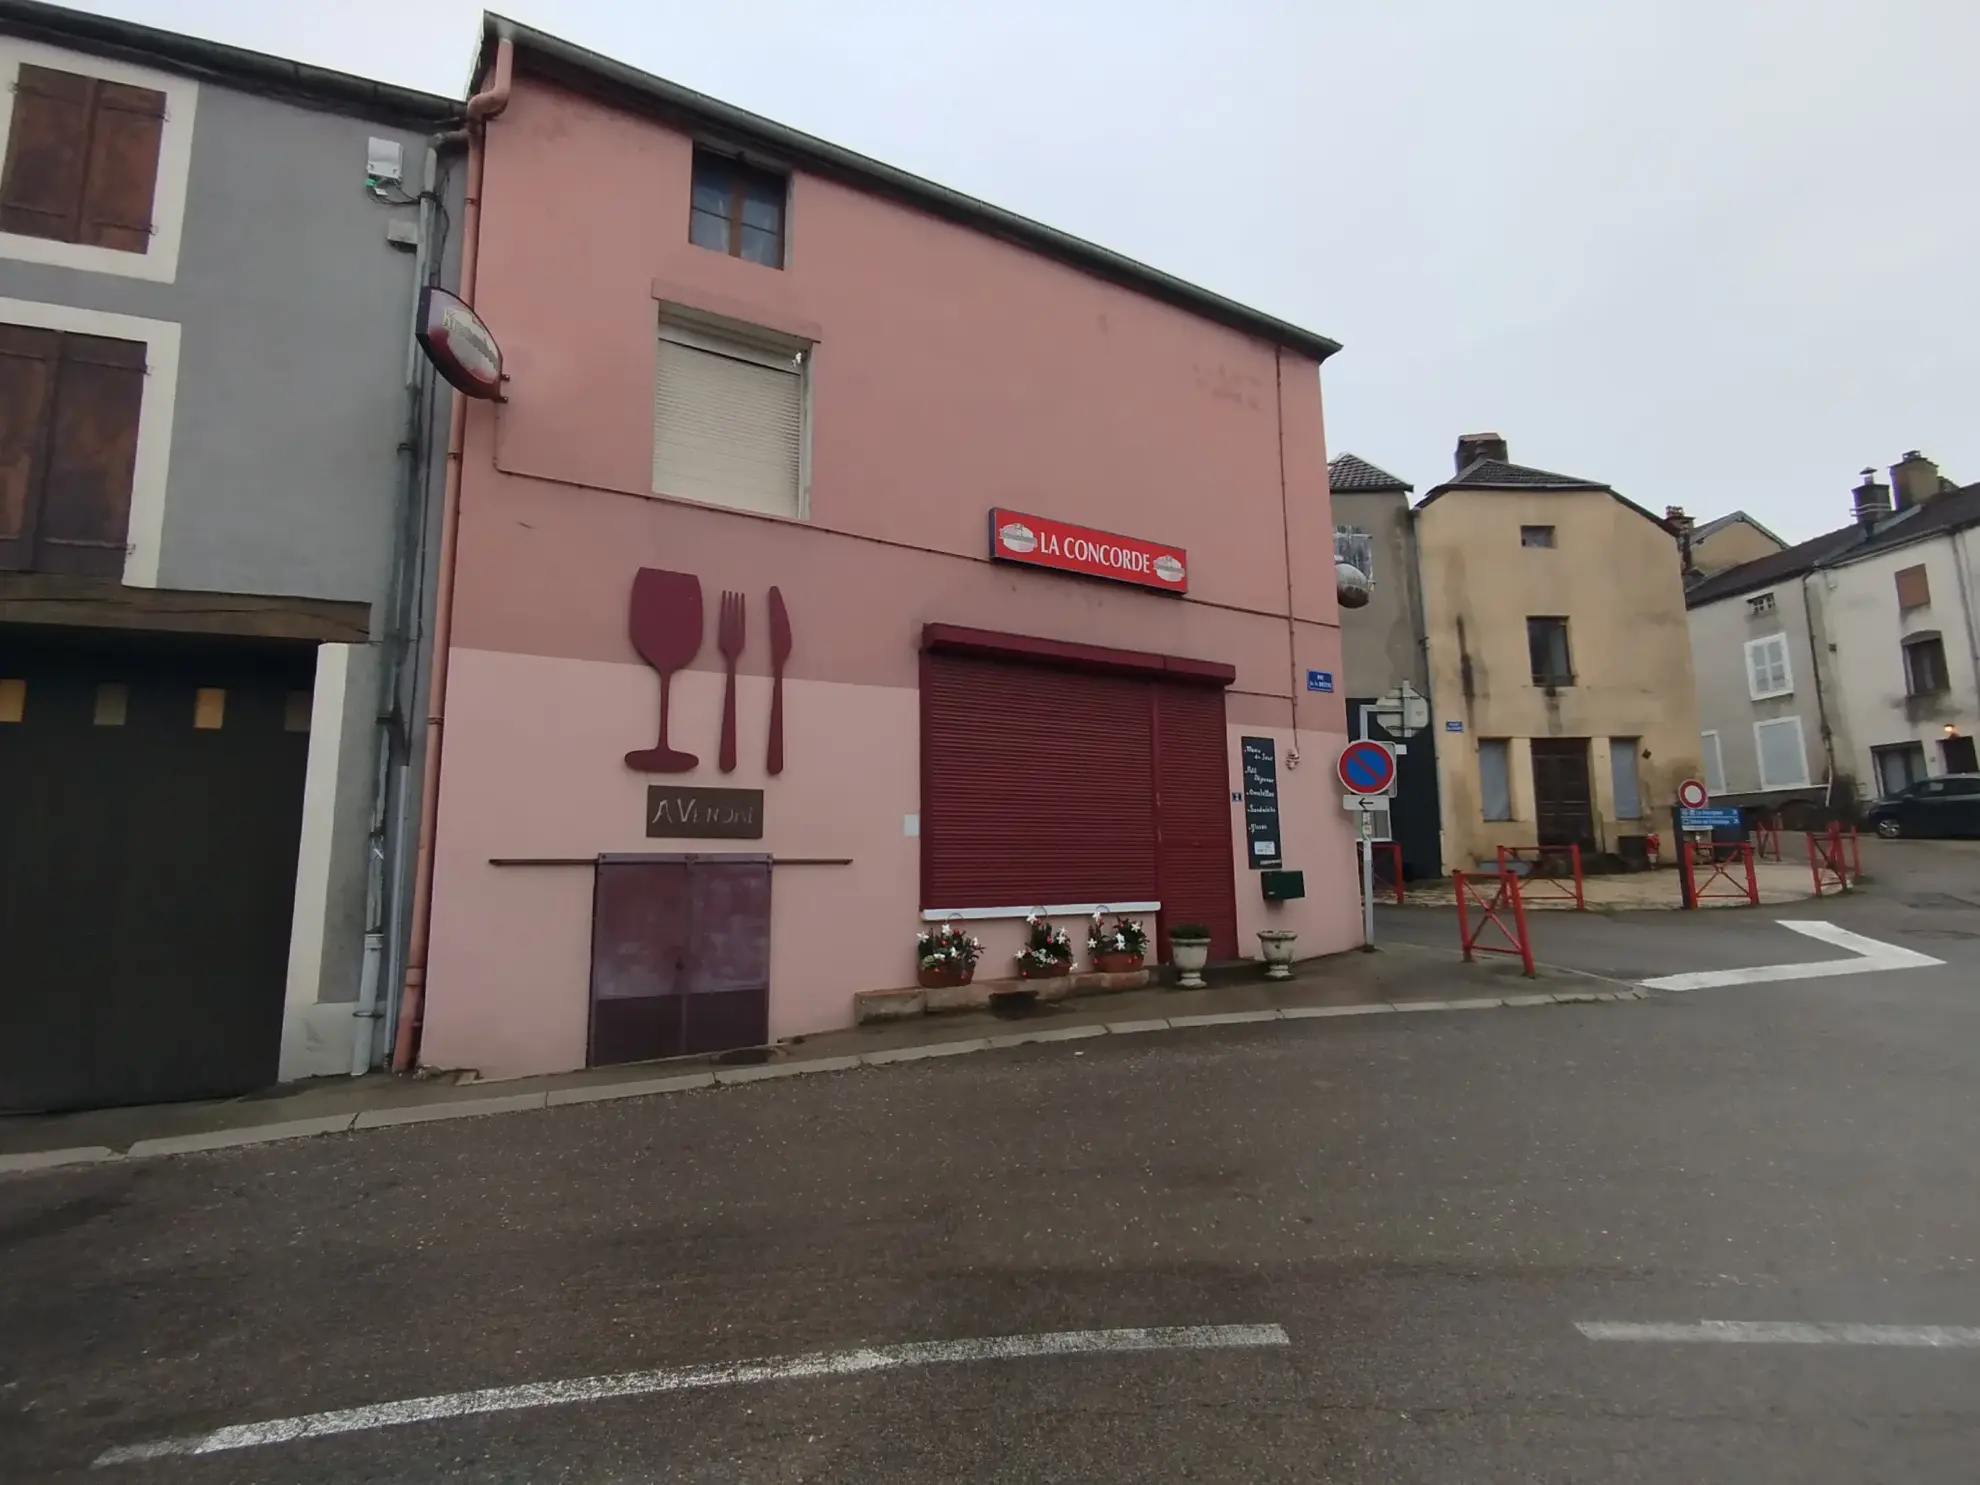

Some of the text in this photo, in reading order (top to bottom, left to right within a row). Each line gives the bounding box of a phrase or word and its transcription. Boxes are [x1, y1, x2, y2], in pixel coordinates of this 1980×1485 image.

[1040, 532, 1059, 556] LA
[1064, 537, 1150, 574] CONCORDE
[652, 799, 673, 824] A
